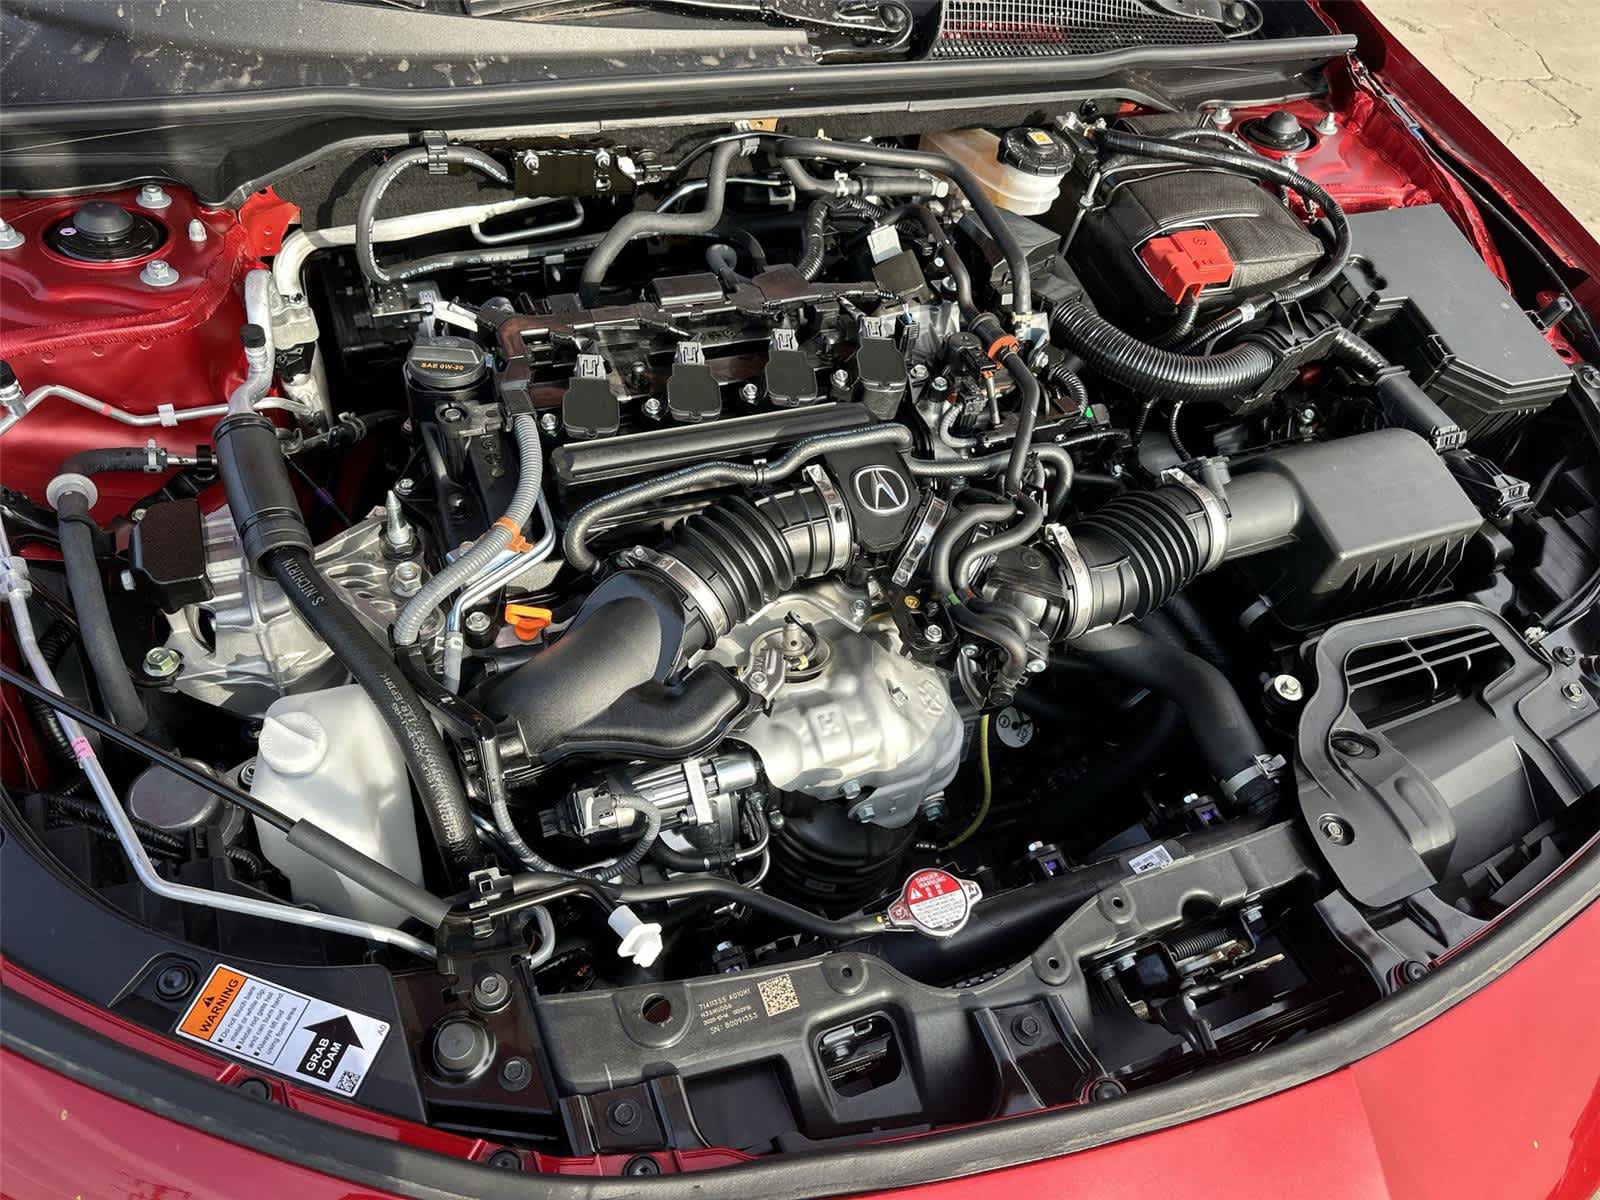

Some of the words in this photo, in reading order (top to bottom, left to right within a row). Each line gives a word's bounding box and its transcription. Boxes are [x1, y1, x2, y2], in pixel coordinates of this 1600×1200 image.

[421, 361, 438, 369] SAE
[440, 363, 465, 372] 0W-20
[200, 979, 239, 1031] WARNING
[220, 1028, 230, 1038] Do
[227, 1017, 236, 1027] not
[233, 1000, 246, 1016] touch
[230, 1024, 243, 1040] metal
[245, 1000, 257, 1015] white
[238, 1027, 251, 1043] Metal
[248, 1016, 258, 1026] rod
[256, 1002, 267, 1016] gets
[263, 991, 272, 1001] hot
[247, 1035, 258, 1047] and
[255, 1023, 265, 1035] can
[256, 1029, 273, 1051] Always
[274, 1009, 284, 1020] rod
[265, 1037, 279, 1054] using
[275, 1021, 287, 1036] foam
[307, 1038, 329, 1071] GRAB
[319, 1042, 342, 1076] FOAM
